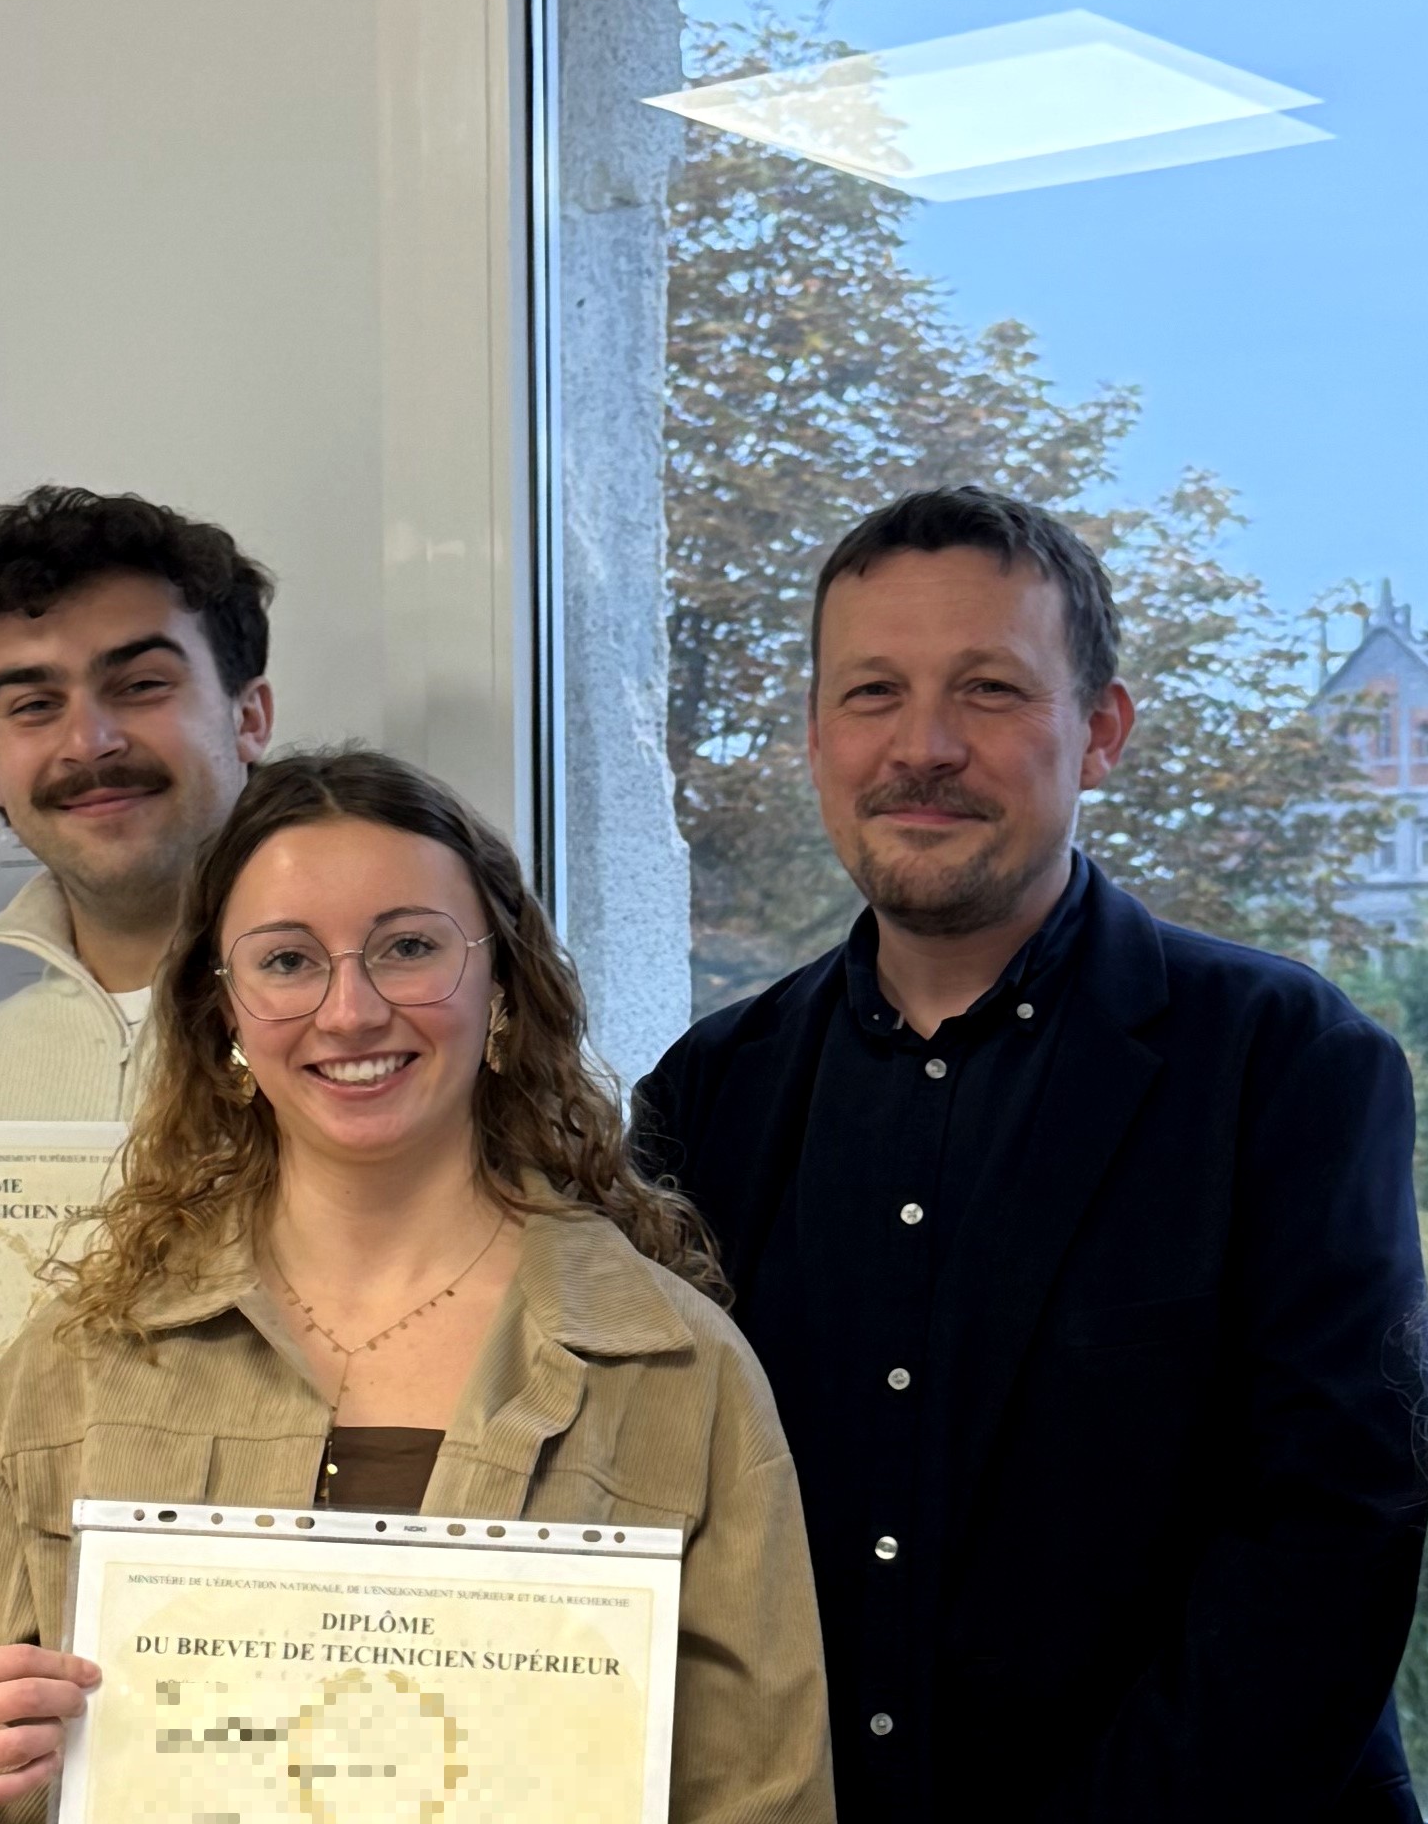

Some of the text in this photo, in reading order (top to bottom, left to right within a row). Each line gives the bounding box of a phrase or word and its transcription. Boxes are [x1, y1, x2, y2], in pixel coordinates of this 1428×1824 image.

[321, 1609, 435, 1636] DIPLÔME
[135, 1635, 169, 1655] DU
[177, 1637, 276, 1659] BREVET
[283, 1642, 314, 1661] DE
[322, 1644, 476, 1669] TECHNICIEN
[483, 1649, 620, 1676] SUPÉRIEUR
